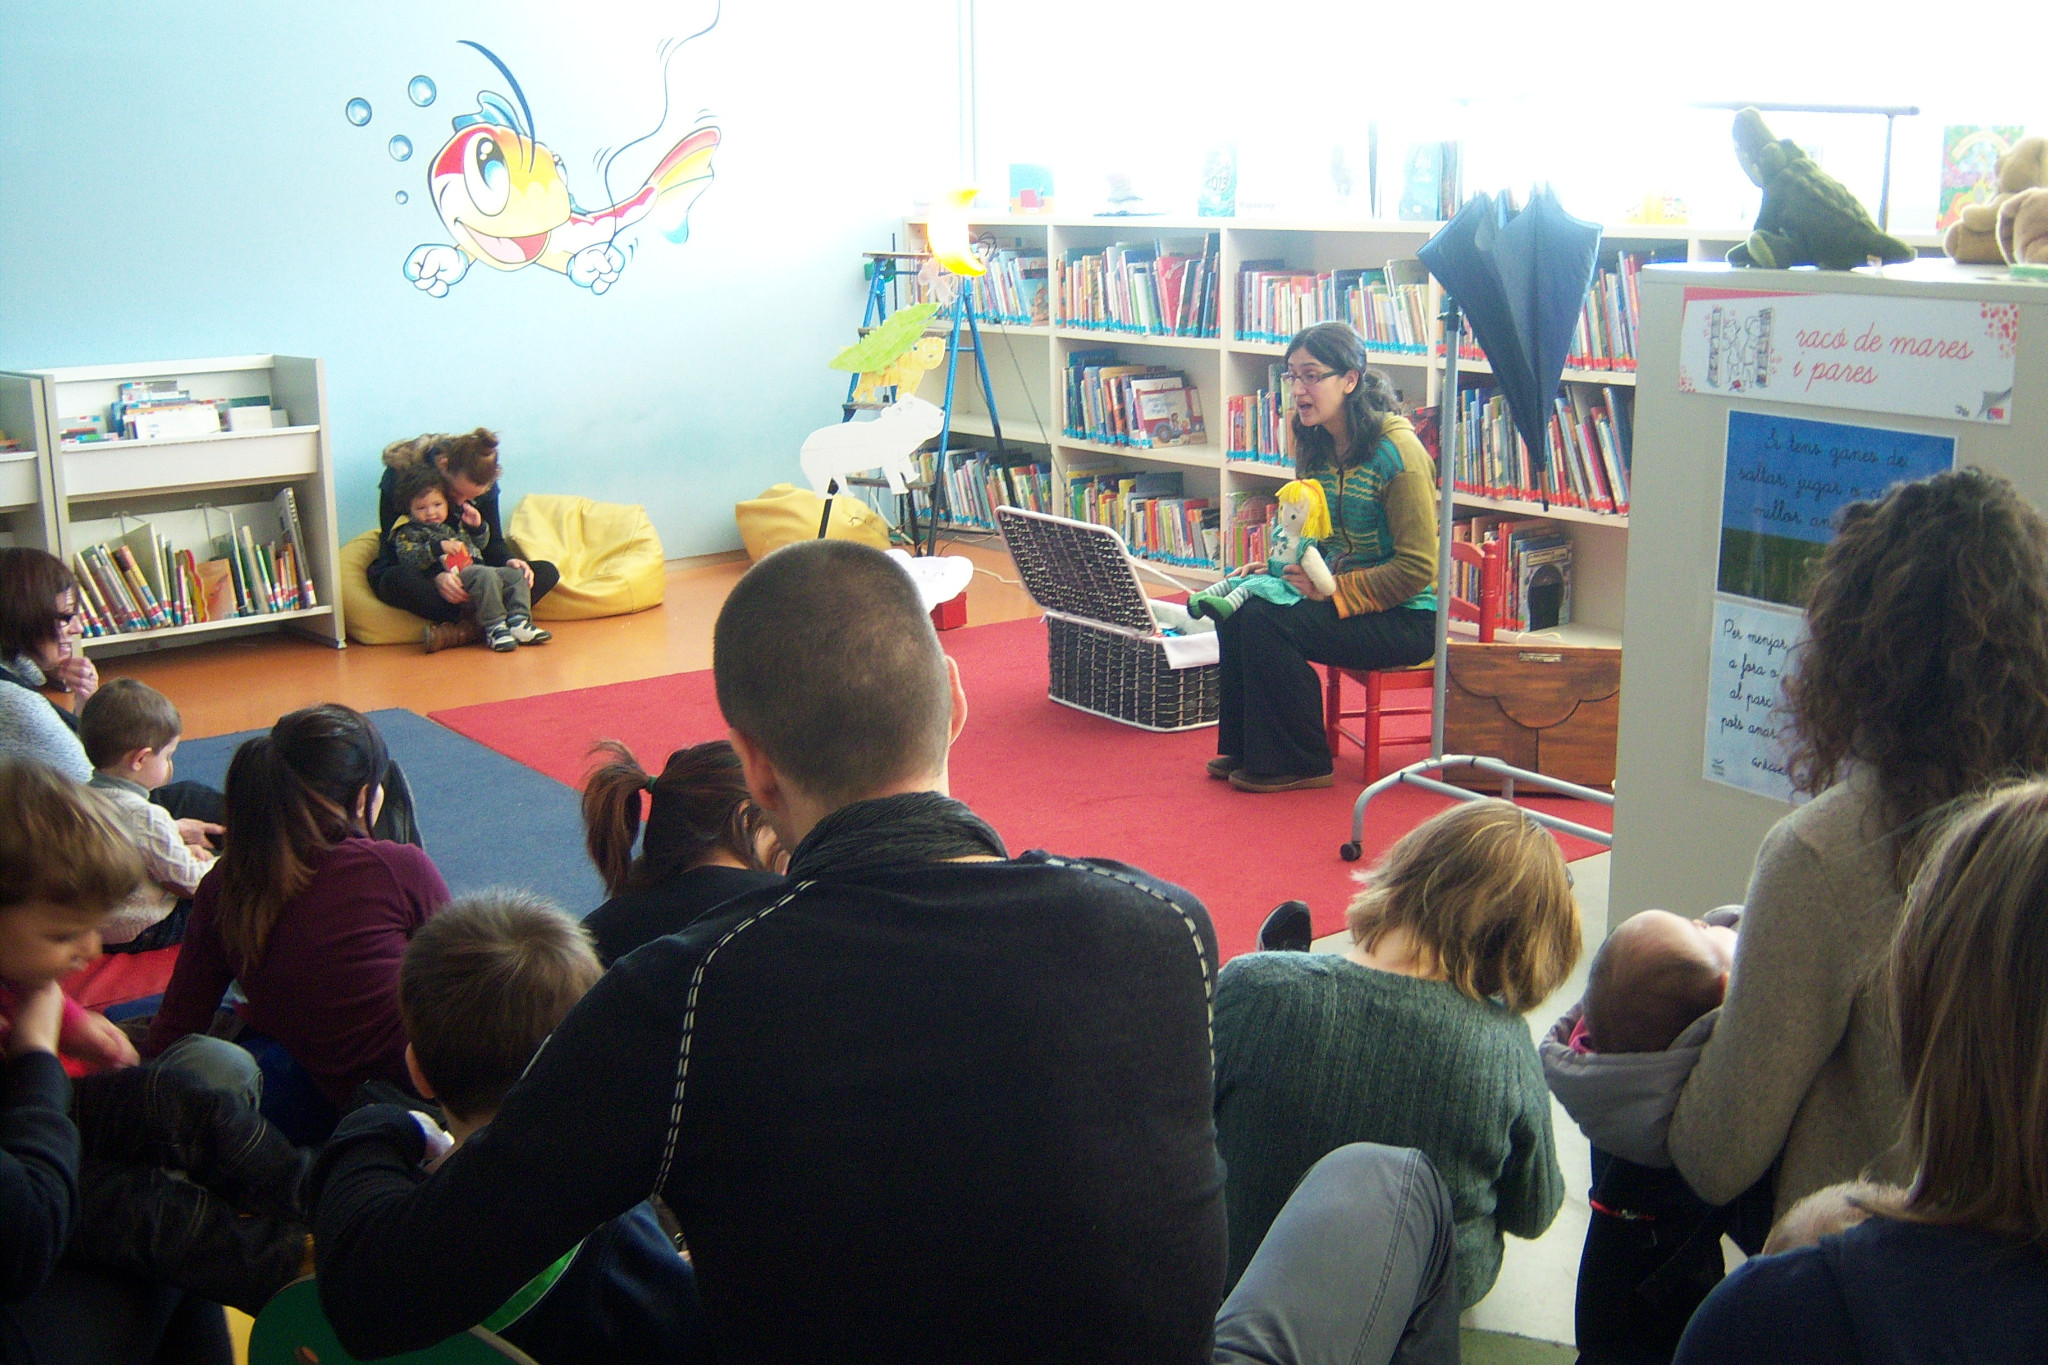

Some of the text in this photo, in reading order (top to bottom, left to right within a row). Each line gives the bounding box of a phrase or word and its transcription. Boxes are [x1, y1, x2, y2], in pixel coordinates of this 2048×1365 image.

[1795, 321, 1975, 360] racó de mares
[1793, 351, 1879, 392] i pares
[1764, 426, 1909, 469] Si tens ganes de
[1796, 478, 1843, 503] jugar
[1723, 618, 1788, 656] Per menjar
[1728, 659, 1737, 669] a
[1740, 653, 1766, 680] fora
[1729, 682, 1773, 712] al parc
